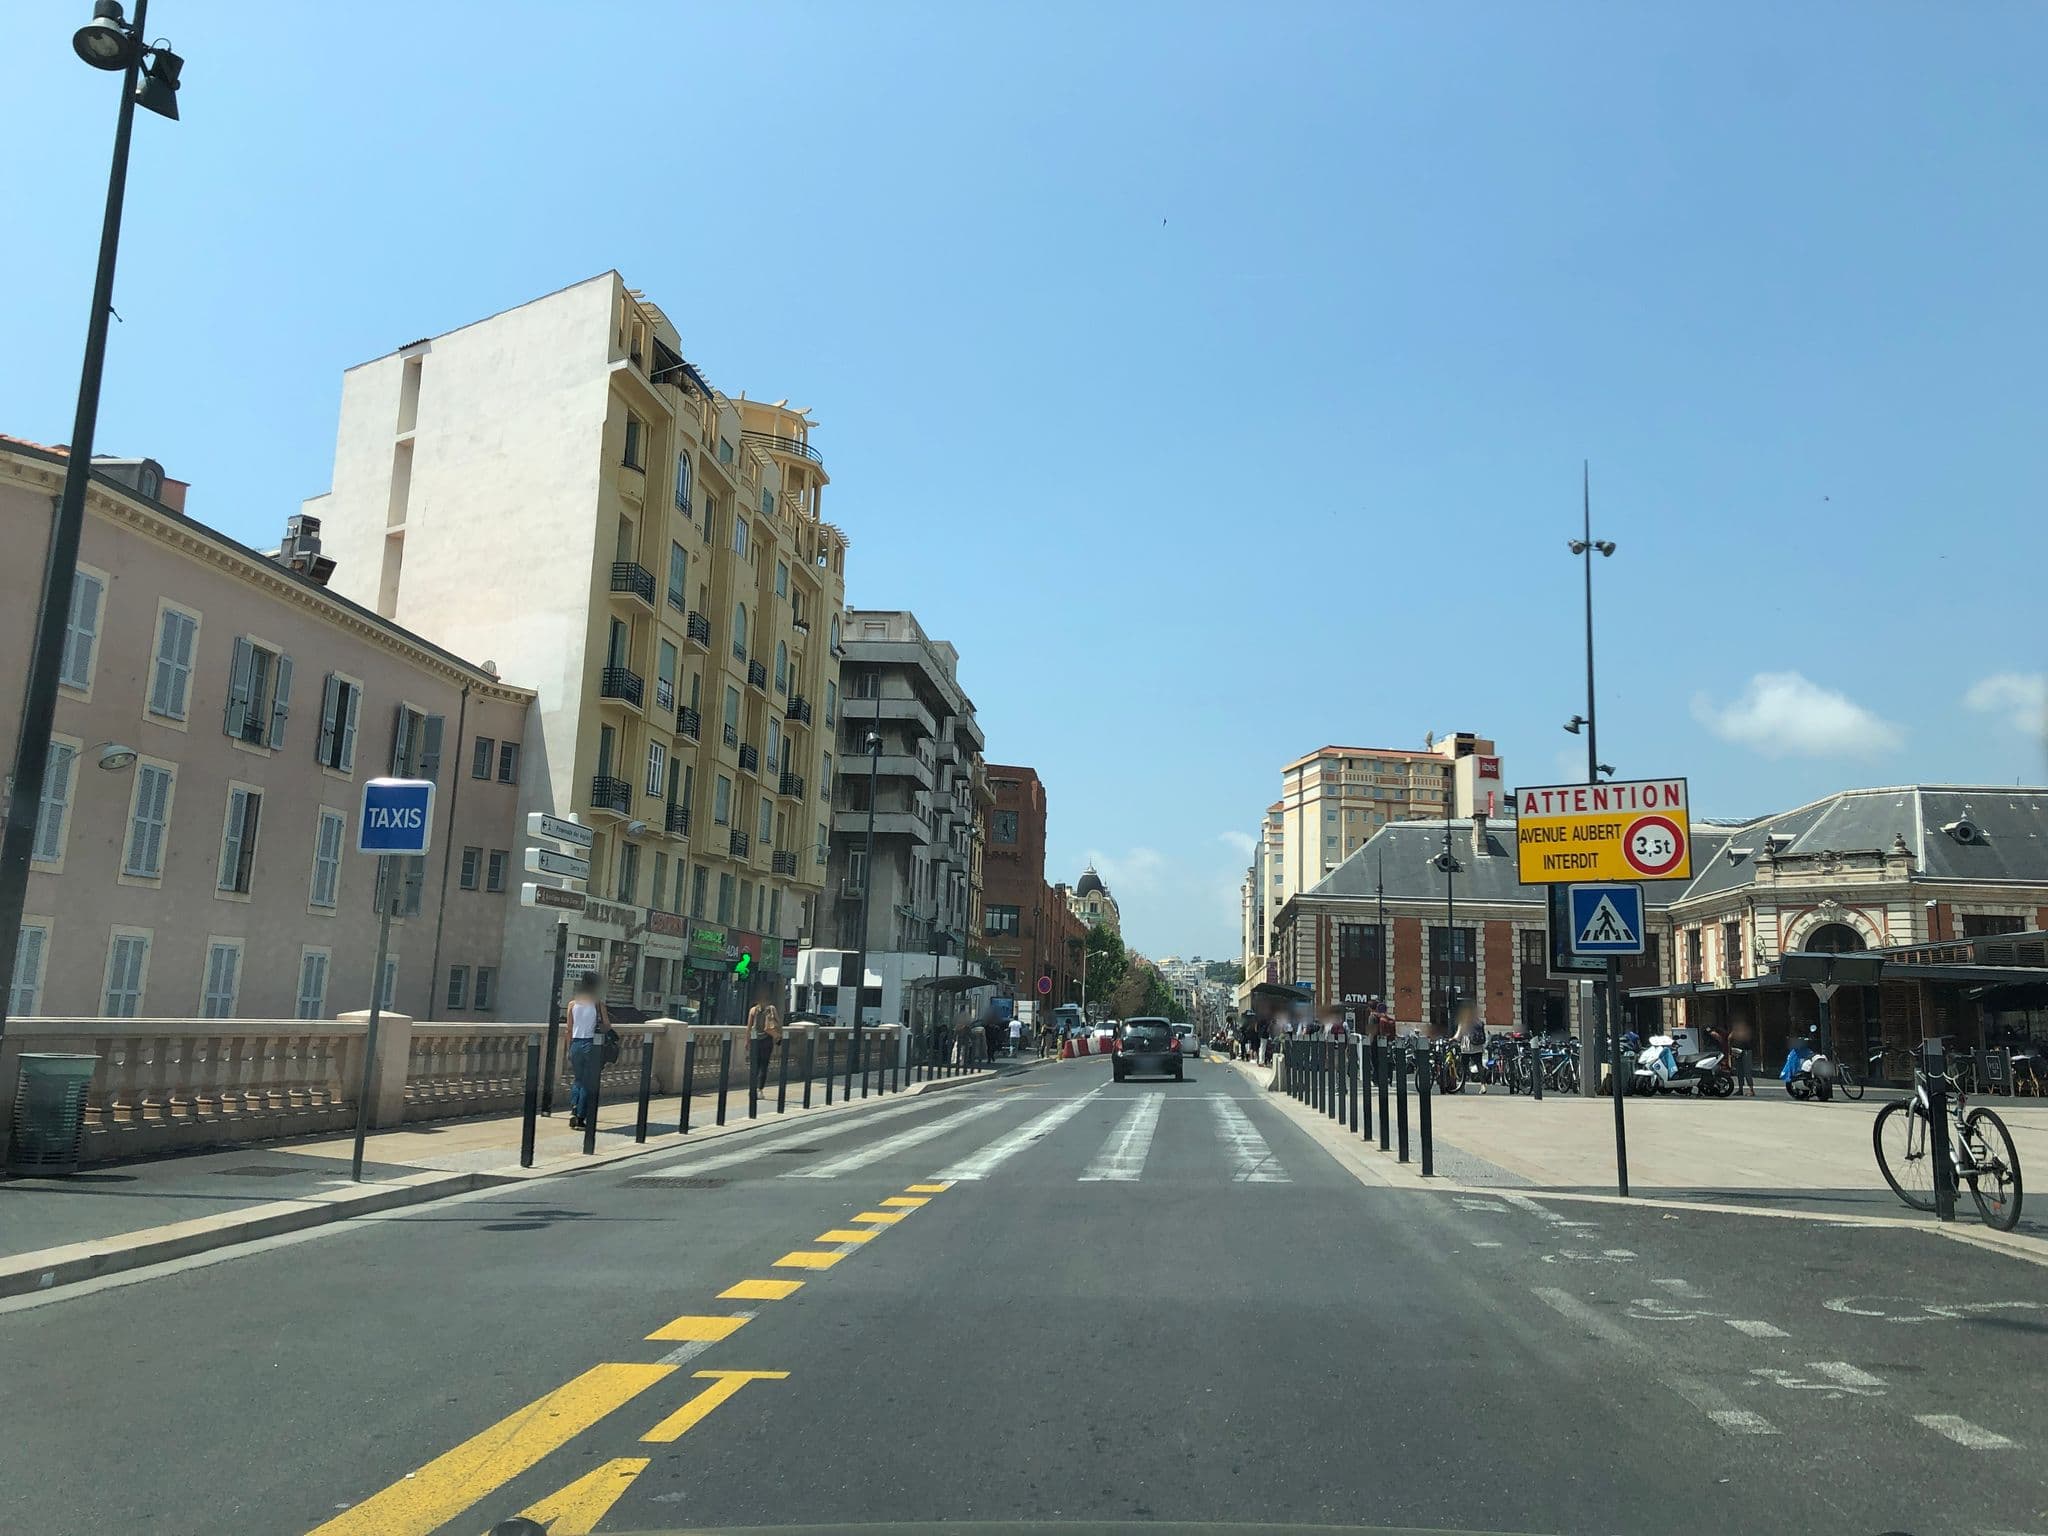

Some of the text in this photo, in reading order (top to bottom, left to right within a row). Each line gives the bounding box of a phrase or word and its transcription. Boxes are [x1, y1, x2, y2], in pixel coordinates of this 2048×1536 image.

[1524, 784, 1680, 814] ATTENTION
[368, 807, 422, 829] TAXIS
[1519, 824, 1622, 844] AVENUE AUBERT
[1636, 836, 1672, 858] 3,5t
[1543, 852, 1599, 870] INTERDIT
[1344, 993, 1368, 1003] ATM
